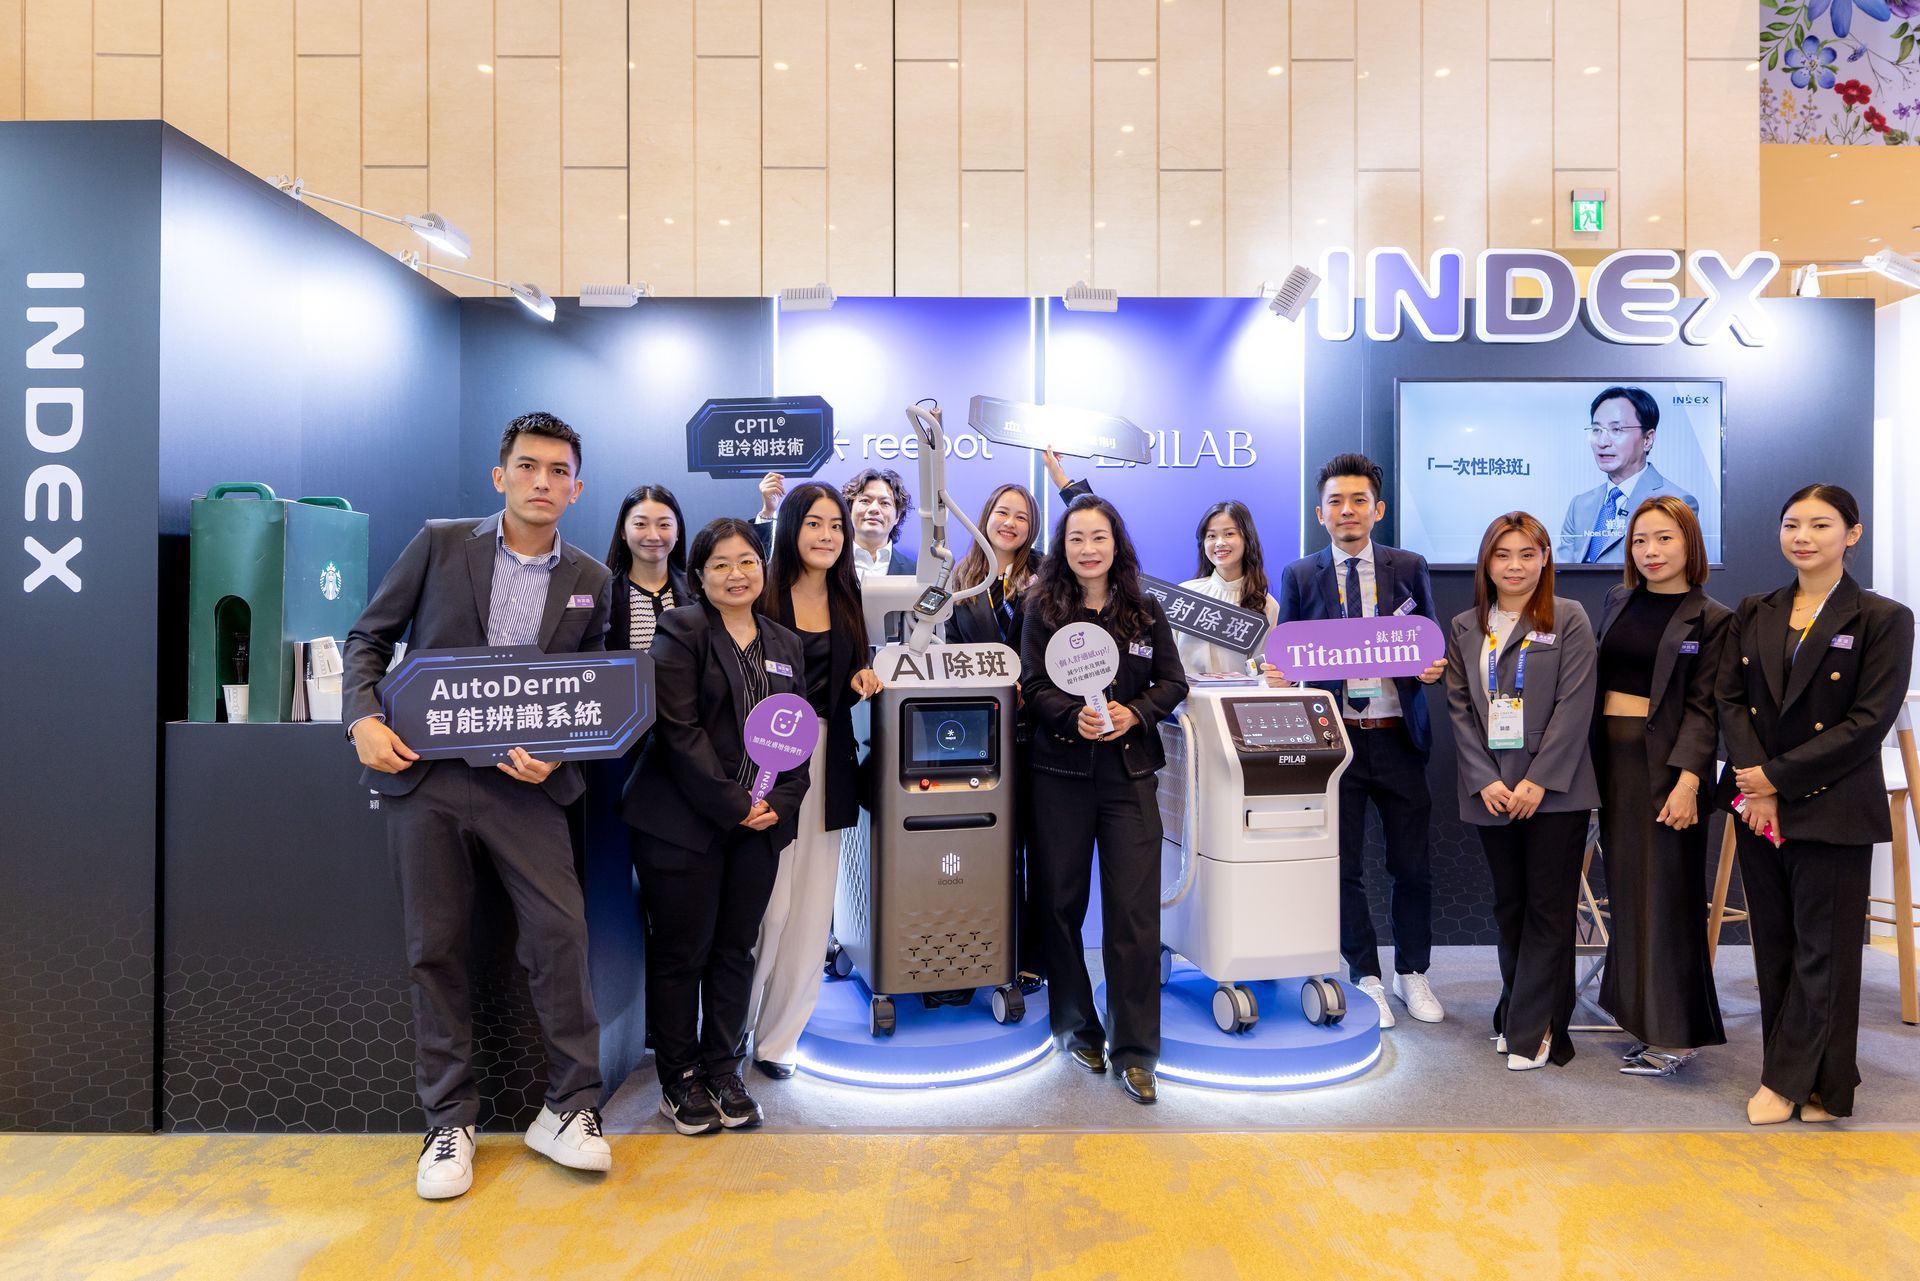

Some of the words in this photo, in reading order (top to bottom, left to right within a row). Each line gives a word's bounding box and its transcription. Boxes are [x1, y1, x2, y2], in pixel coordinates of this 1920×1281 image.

[1318, 246, 1780, 345] INDEX
[24, 273, 85, 593] INDEX
[718, 438, 804, 457] 超冷卻技術
[1096, 430, 1257, 468] ILAB
[1427, 457, 1530, 476] 「一次性除斑」
[1287, 640, 1421, 668] Titanium
[426, 700, 602, 736] 智能辨識系統
[1279, 755, 1306, 764] EPILAB
